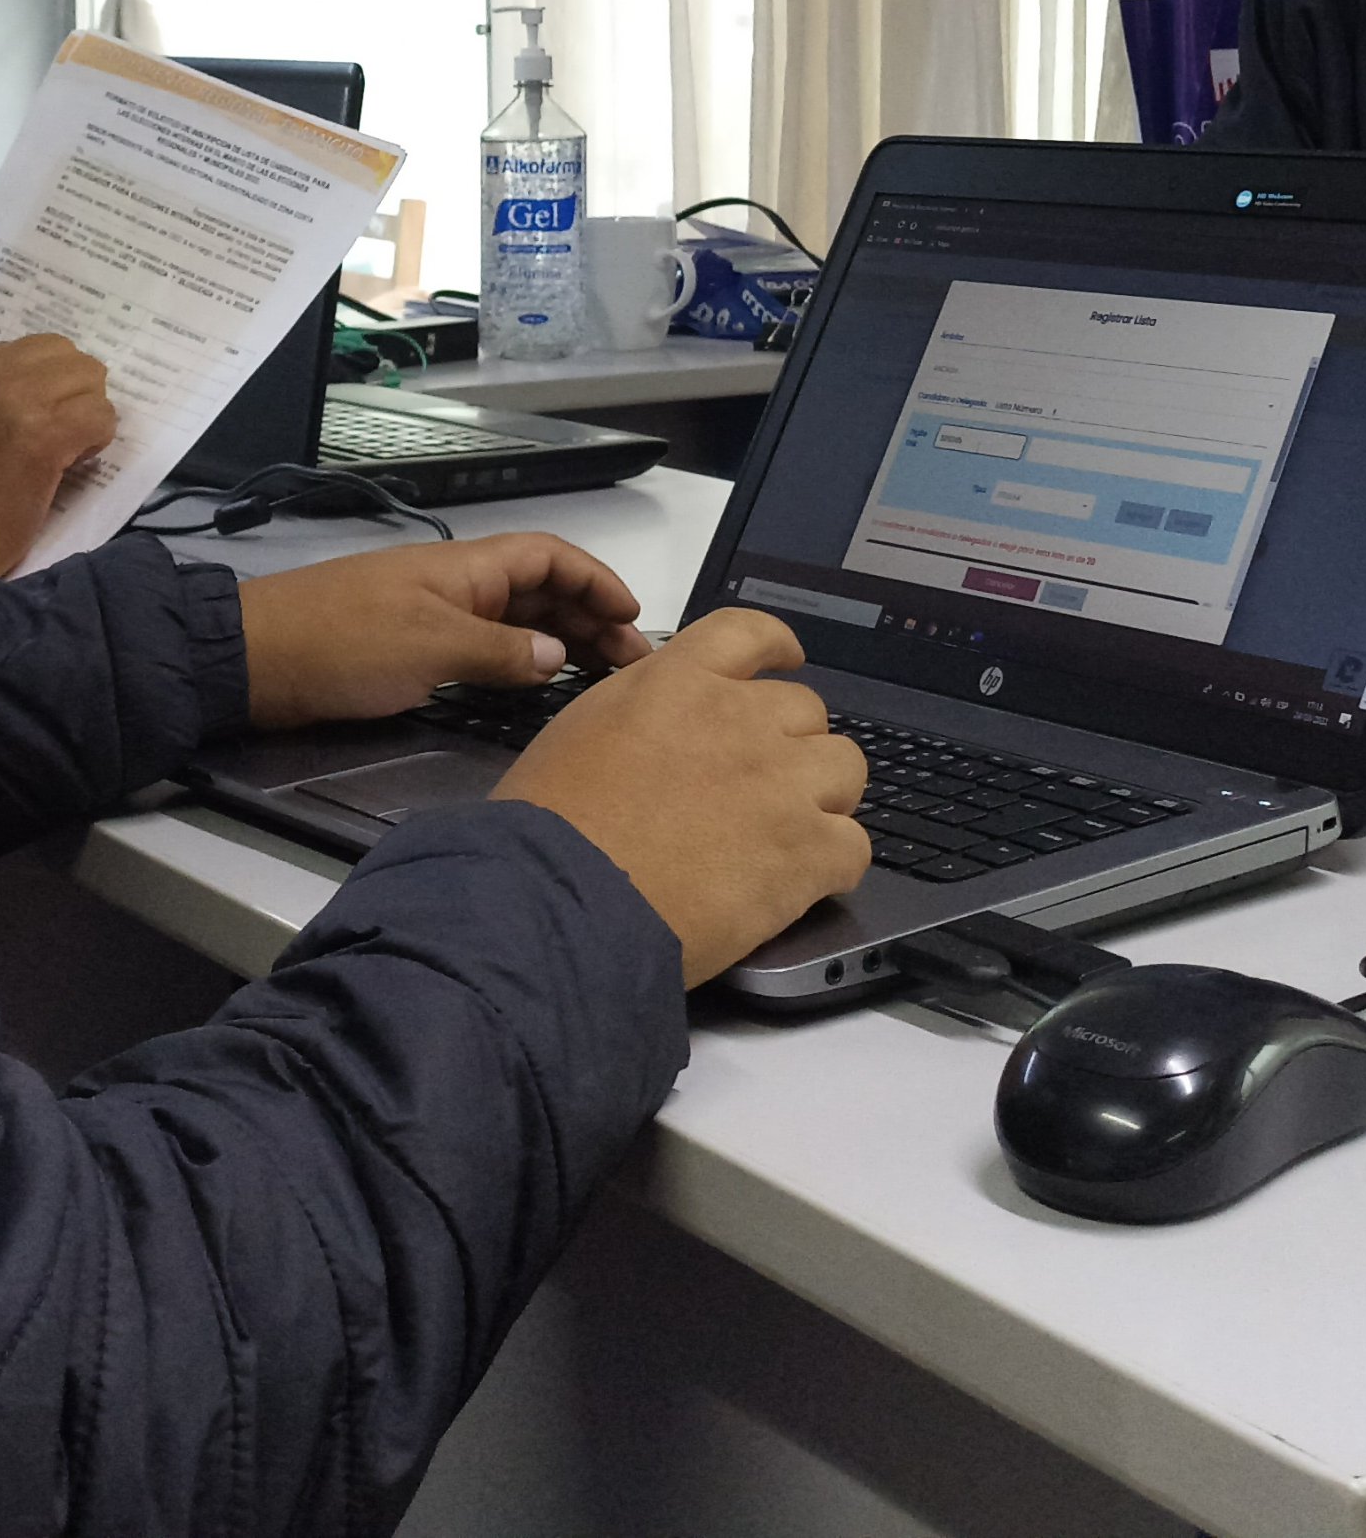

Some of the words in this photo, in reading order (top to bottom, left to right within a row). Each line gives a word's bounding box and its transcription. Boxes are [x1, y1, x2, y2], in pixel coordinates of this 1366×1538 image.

[507, 202, 559, 229] Gel
[1089, 310, 1134, 327] Registrar
[1134, 315, 1158, 327] Lista
